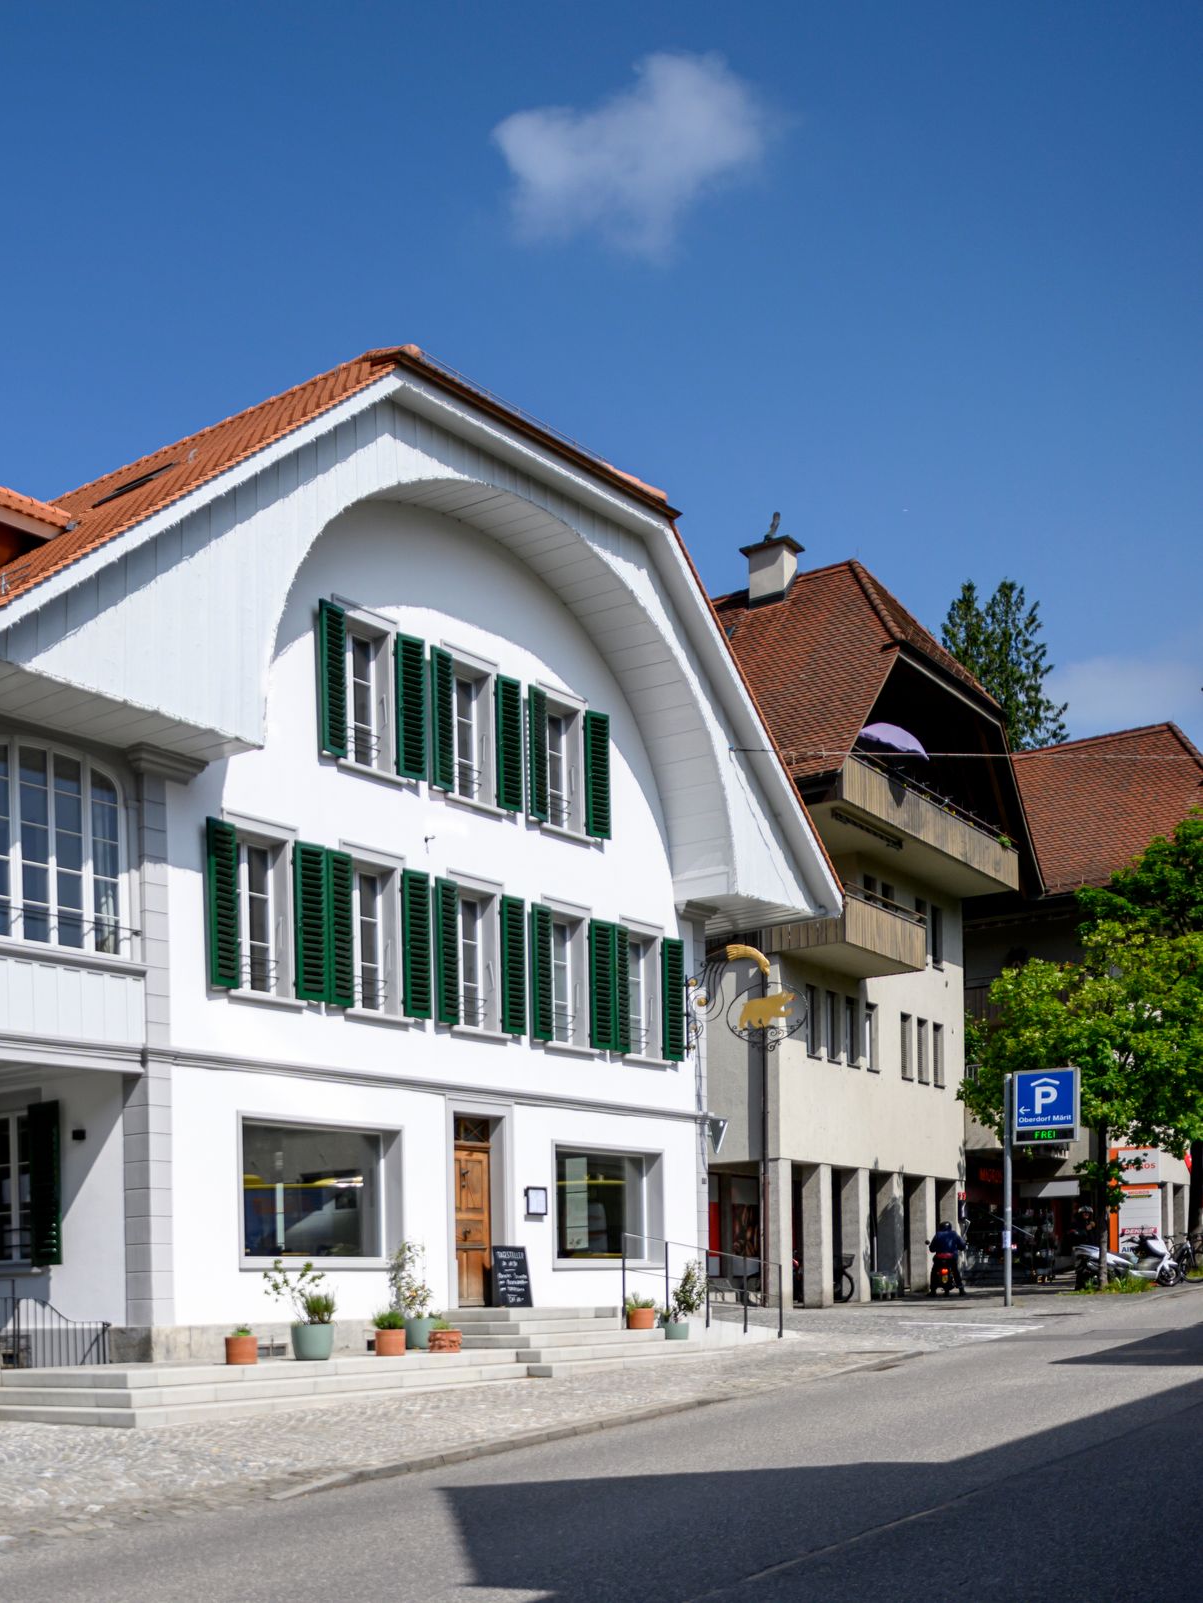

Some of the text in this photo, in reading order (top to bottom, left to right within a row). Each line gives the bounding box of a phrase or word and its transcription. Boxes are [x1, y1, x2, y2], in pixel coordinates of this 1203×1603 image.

[1034, 1086, 1058, 1114] P
[1018, 1115, 1051, 1123] Oberdorf
[1034, 1130, 1056, 1139] FREI
